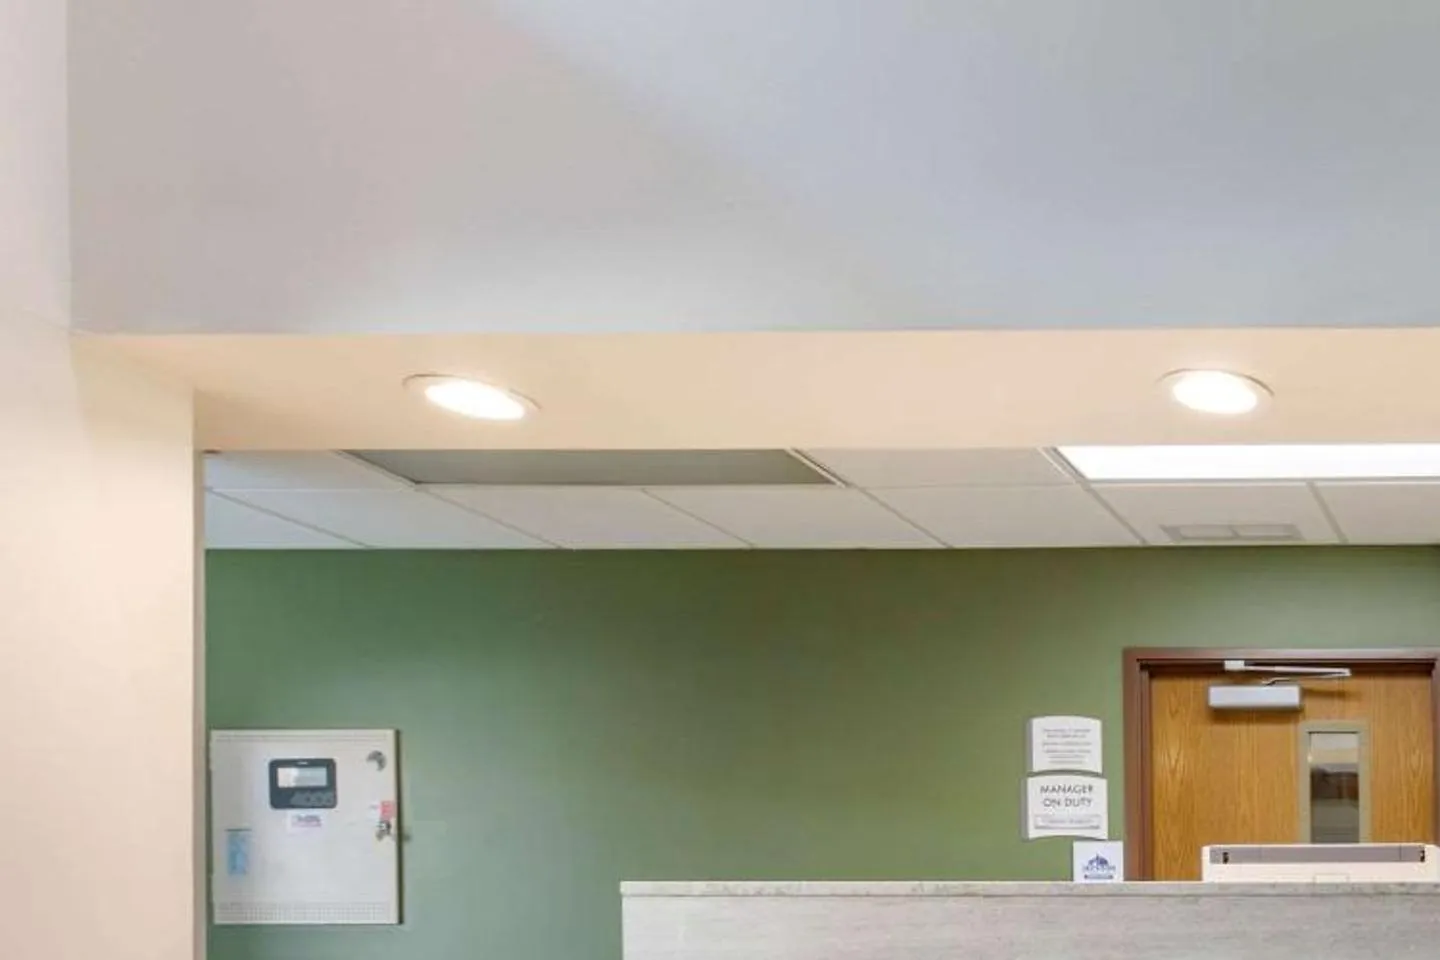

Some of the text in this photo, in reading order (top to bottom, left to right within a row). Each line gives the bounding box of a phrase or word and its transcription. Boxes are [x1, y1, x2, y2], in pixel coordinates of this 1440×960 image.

[1040, 784, 1093, 794] MANAGER
[1043, 797, 1092, 808] ON DUTY
